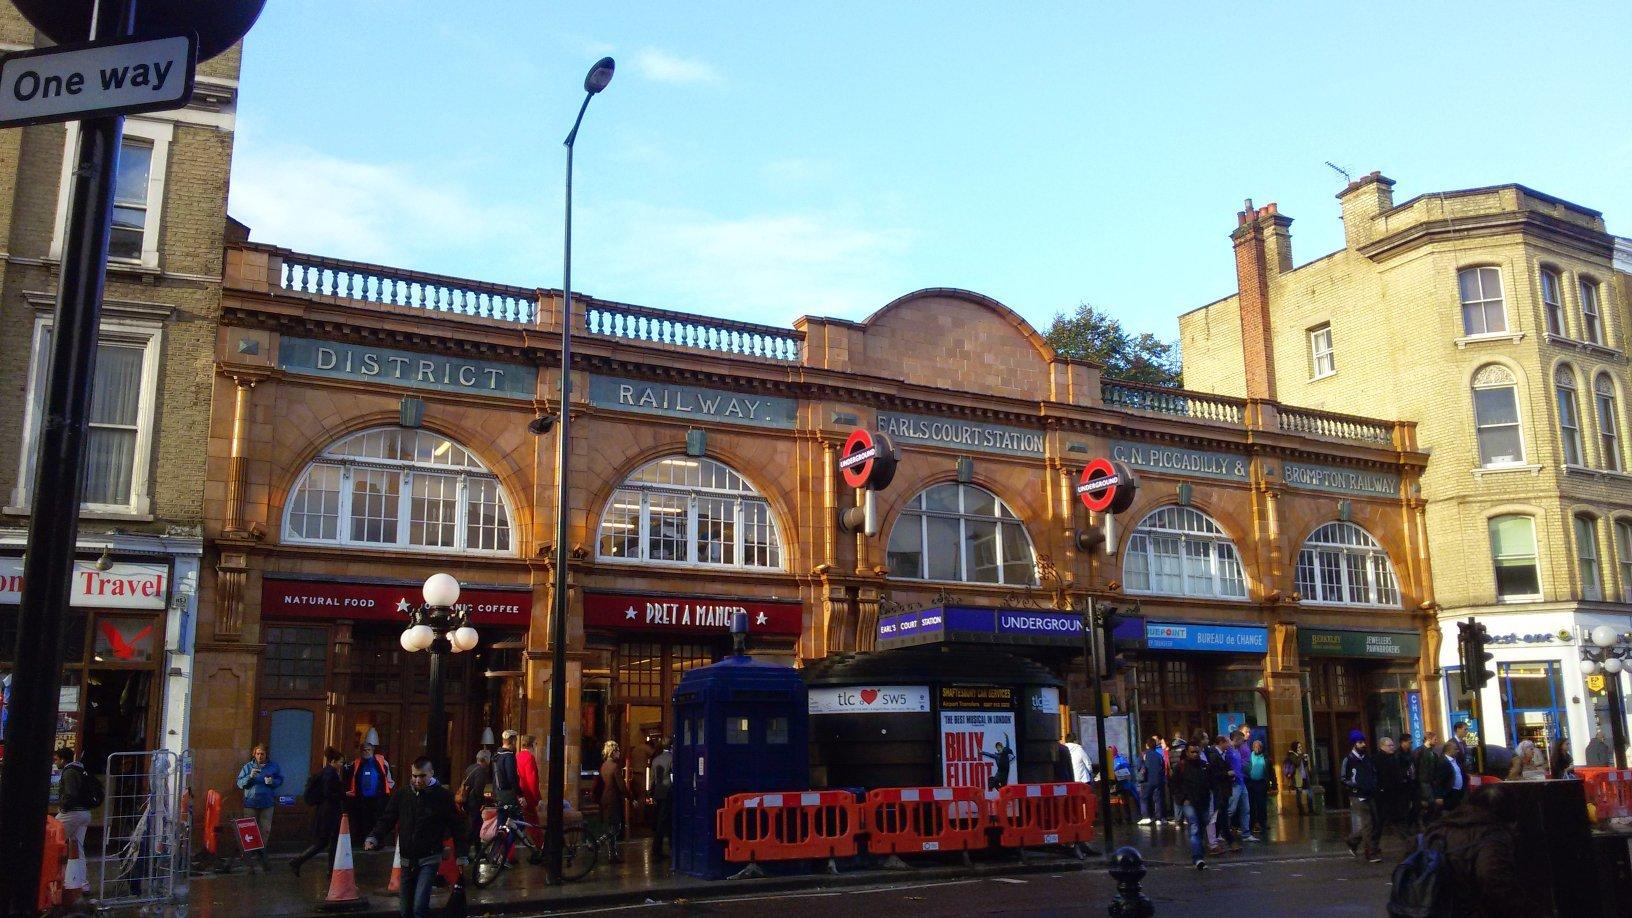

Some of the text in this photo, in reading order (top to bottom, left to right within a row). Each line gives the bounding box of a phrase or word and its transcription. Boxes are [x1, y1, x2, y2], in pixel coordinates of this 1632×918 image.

[13, 60, 174, 102] One way
[316, 347, 505, 390] DISTRICT
[877, 415, 1044, 453] EARLS COURT STATION
[839, 448, 876, 468] UNDERGROUND
[1131, 447, 1146, 465] N.
[1150, 448, 1230, 474] PICCADILLY
[1234, 459, 1246, 477] &
[1077, 476, 1119, 493] UNDERGROUND
[1284, 466, 1396, 494] BROMPTON RAILWAY
[80, 570, 164, 598] Travel
[284, 595, 376, 608] NATURAL FOOD
[478, 604, 520, 614] COFFEE
[645, 602, 748, 628] PRET A MANG
[880, 615, 942, 634] EARL'S COURT STATION
[1001, 615, 1090, 633] UNDERGROUN
[1197, 632, 1263, 646] BUREAU de CHANGE
[1366, 635, 1393, 645] JEWELLERS
[837, 691, 856, 706] tlc
[882, 693, 907, 705] SW5
[944, 731, 985, 762] BILLY
